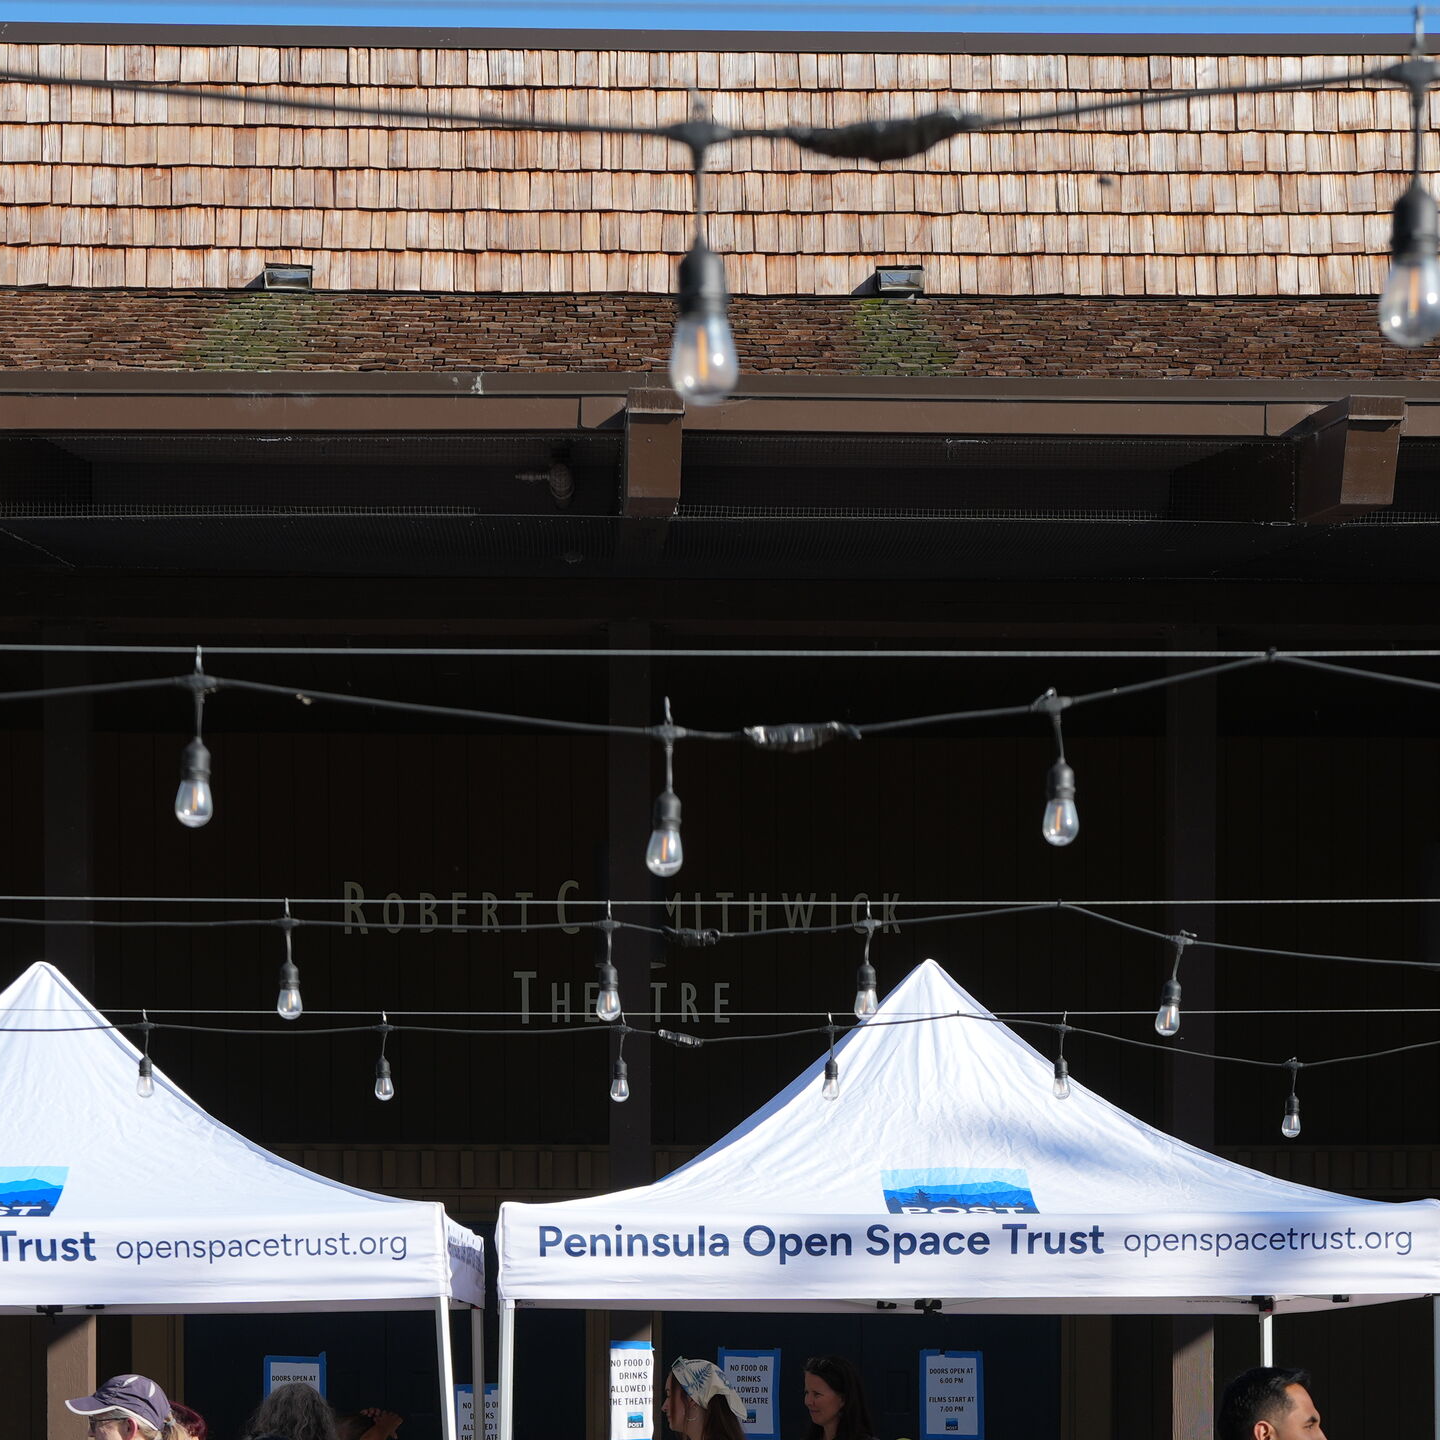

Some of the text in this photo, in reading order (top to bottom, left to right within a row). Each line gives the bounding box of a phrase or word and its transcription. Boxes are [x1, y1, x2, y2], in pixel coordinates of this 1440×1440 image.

[343, 881, 534, 935] ROBERT
[664, 891, 903, 936] MITHWICK
[513, 970, 731, 1025] THETRE
[900, 1206, 1025, 1215] POST
[116, 1232, 407, 1265] openspacetrust.org
[539, 1223, 1413, 1265] Peninsula Open Space Trust openspacetrust.org
[610, 1358, 652, 1367] NO FOOD O
[619, 1371, 648, 1380] DRINKS
[610, 1384, 647, 1393] ALLOWED
[609, 1397, 652, 1406] THE THEATR
[462, 1423, 493, 1431] ALLED
